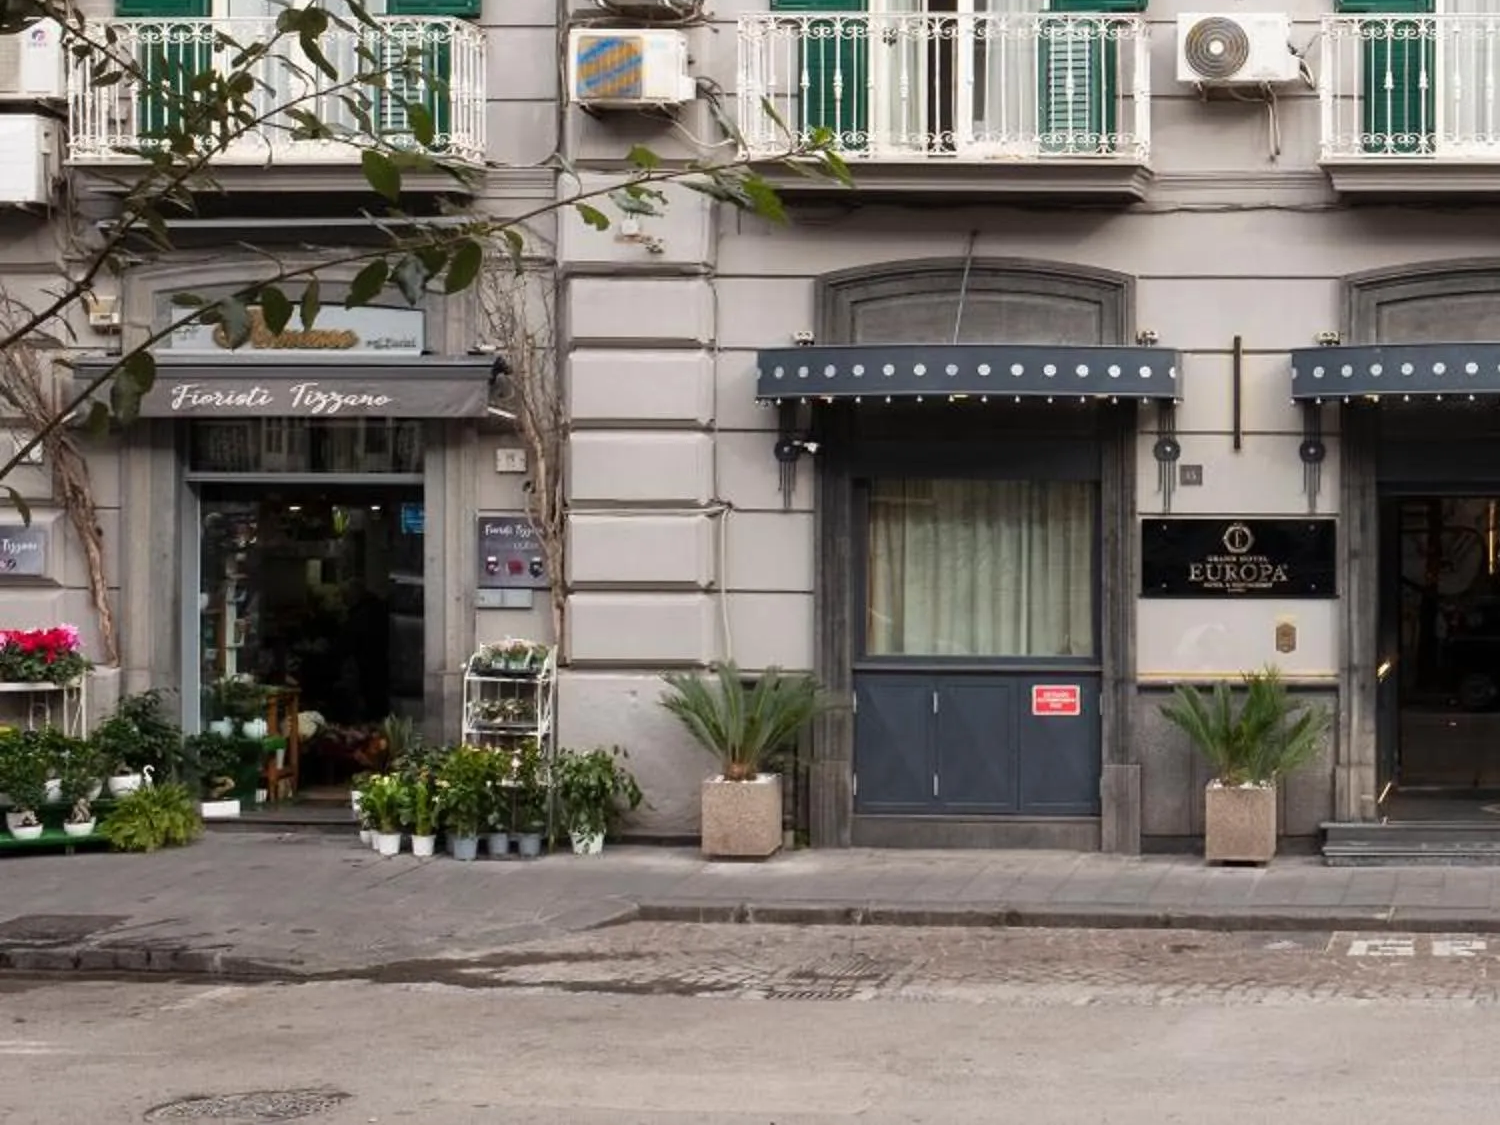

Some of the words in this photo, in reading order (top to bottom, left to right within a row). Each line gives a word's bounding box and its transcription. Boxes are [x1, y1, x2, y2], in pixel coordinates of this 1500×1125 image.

[171, 382, 273, 410] Fioristi
[290, 382, 393, 414] Tizzano
[1188, 563, 1288, 581] EUROPA
